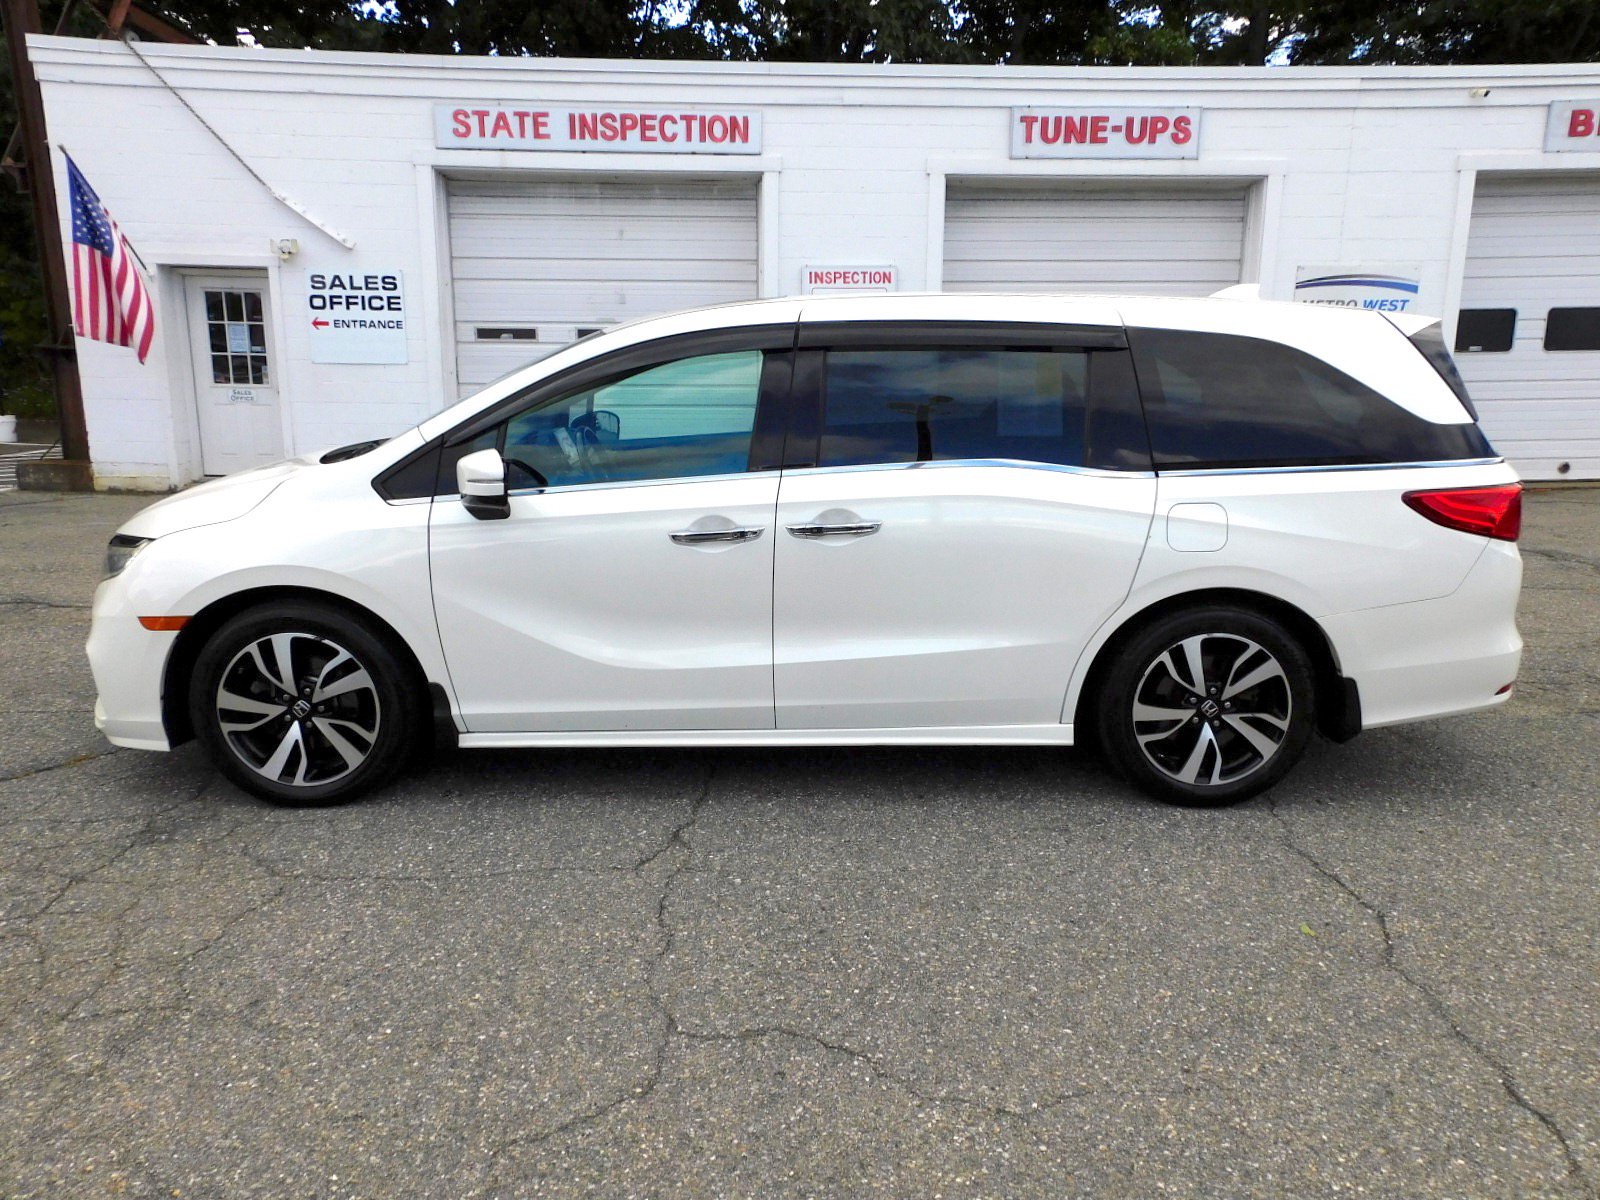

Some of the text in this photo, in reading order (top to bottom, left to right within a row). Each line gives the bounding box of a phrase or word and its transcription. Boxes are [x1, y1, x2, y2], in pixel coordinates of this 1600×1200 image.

[451, 109, 749, 143] STATE INSPECTION
[1020, 115, 1192, 145] TUNE-UPS
[1568, 109, 1600, 137] B
[310, 274, 398, 291] SALES
[808, 271, 892, 285] INSPECTION
[309, 294, 402, 311] OFFICE
[1362, 299, 1410, 312] WEST
[333, 319, 404, 330] ENTRANCE
